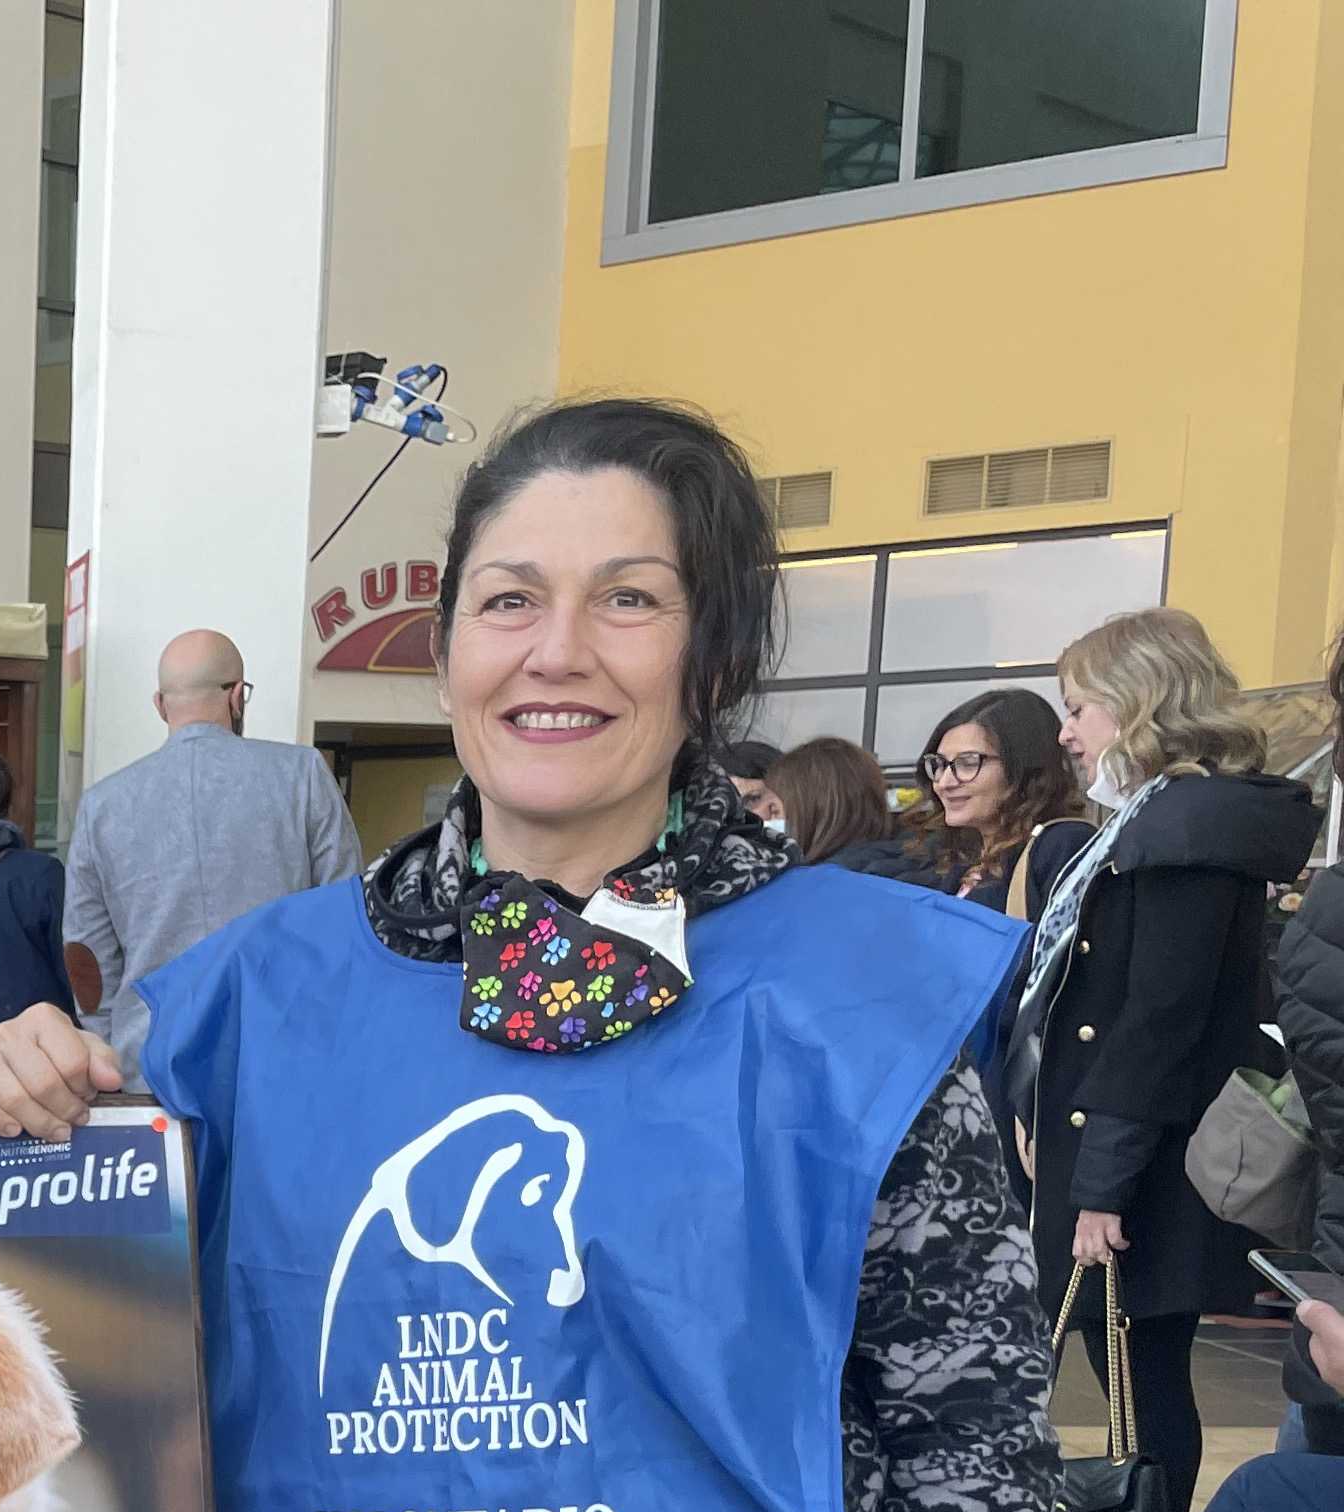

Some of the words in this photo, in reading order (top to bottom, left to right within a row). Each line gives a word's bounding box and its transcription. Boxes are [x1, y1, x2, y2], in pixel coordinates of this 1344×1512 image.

[397, 1308, 510, 1359] LNDC
[372, 1355, 534, 1408] ANIMAL
[327, 1399, 589, 1455] PROTECTION
